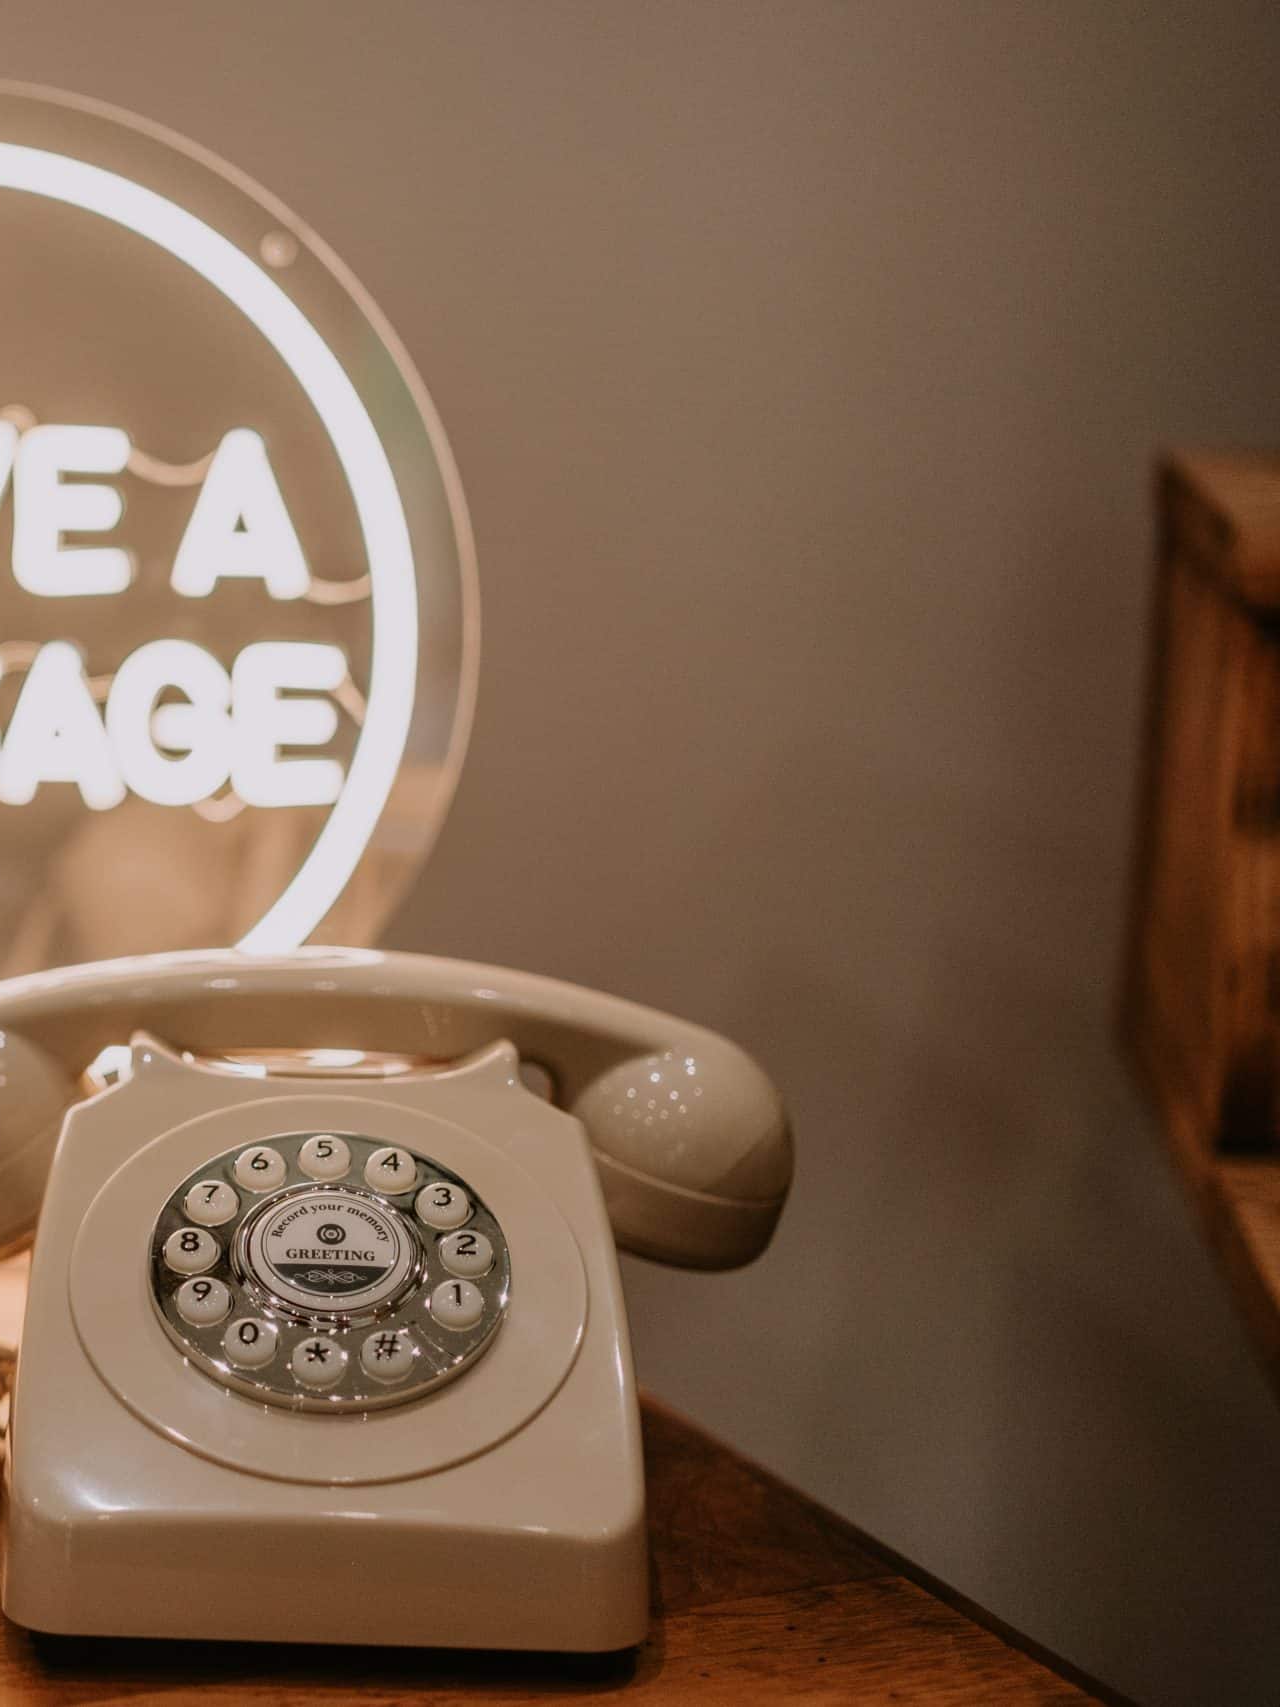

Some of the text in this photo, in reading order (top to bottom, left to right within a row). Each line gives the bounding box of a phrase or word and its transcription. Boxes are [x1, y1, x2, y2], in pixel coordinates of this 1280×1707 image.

[170, 427, 314, 600] A
[316, 1140, 334, 1159] 5
[250, 1152, 270, 1171] 6
[380, 1152, 401, 1172] 4
[202, 1185, 220, 1204] 7
[432, 1187, 452, 1207] 3
[271, 1203, 390, 1243] Record your memory
[179, 1231, 201, 1252] 8
[456, 1235, 478, 1256] 2
[285, 1247, 376, 1262] GREETING
[192, 1282, 212, 1302] 9
[452, 1283, 463, 1307] 1
[238, 1321, 259, 1346] 0
